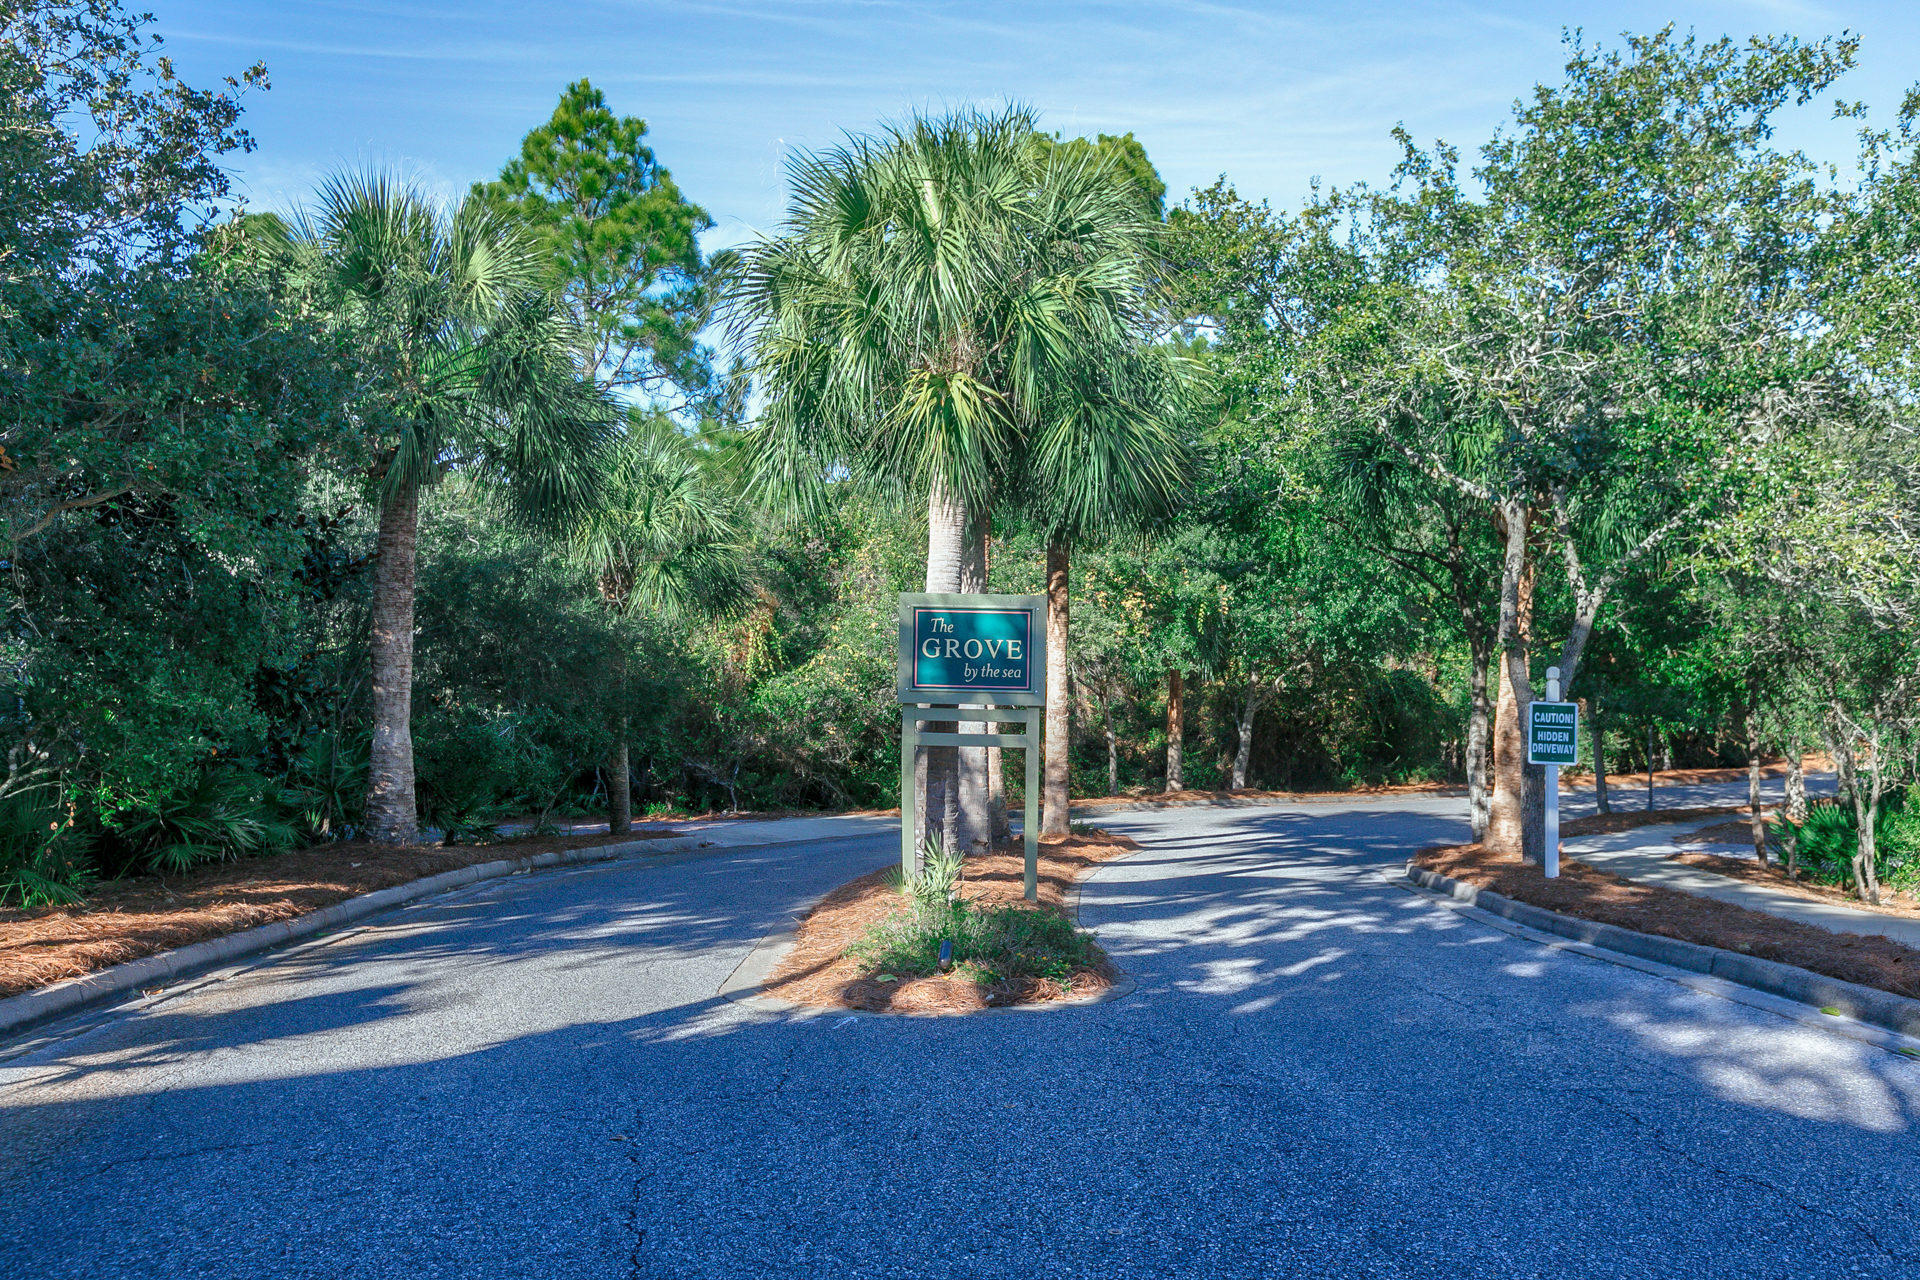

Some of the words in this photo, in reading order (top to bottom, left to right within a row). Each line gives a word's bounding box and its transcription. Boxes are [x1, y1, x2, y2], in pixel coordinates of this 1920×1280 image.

[931, 617, 954, 633] The
[922, 638, 1023, 660] GROVE
[964, 663, 978, 682] by
[981, 663, 999, 678] the
[1002, 668, 1022, 678] sea
[1534, 712, 1574, 723] CAUTION!
[1537, 731, 1569, 742] HIDDEN
[1532, 743, 1574, 754] DRIVEWAY
